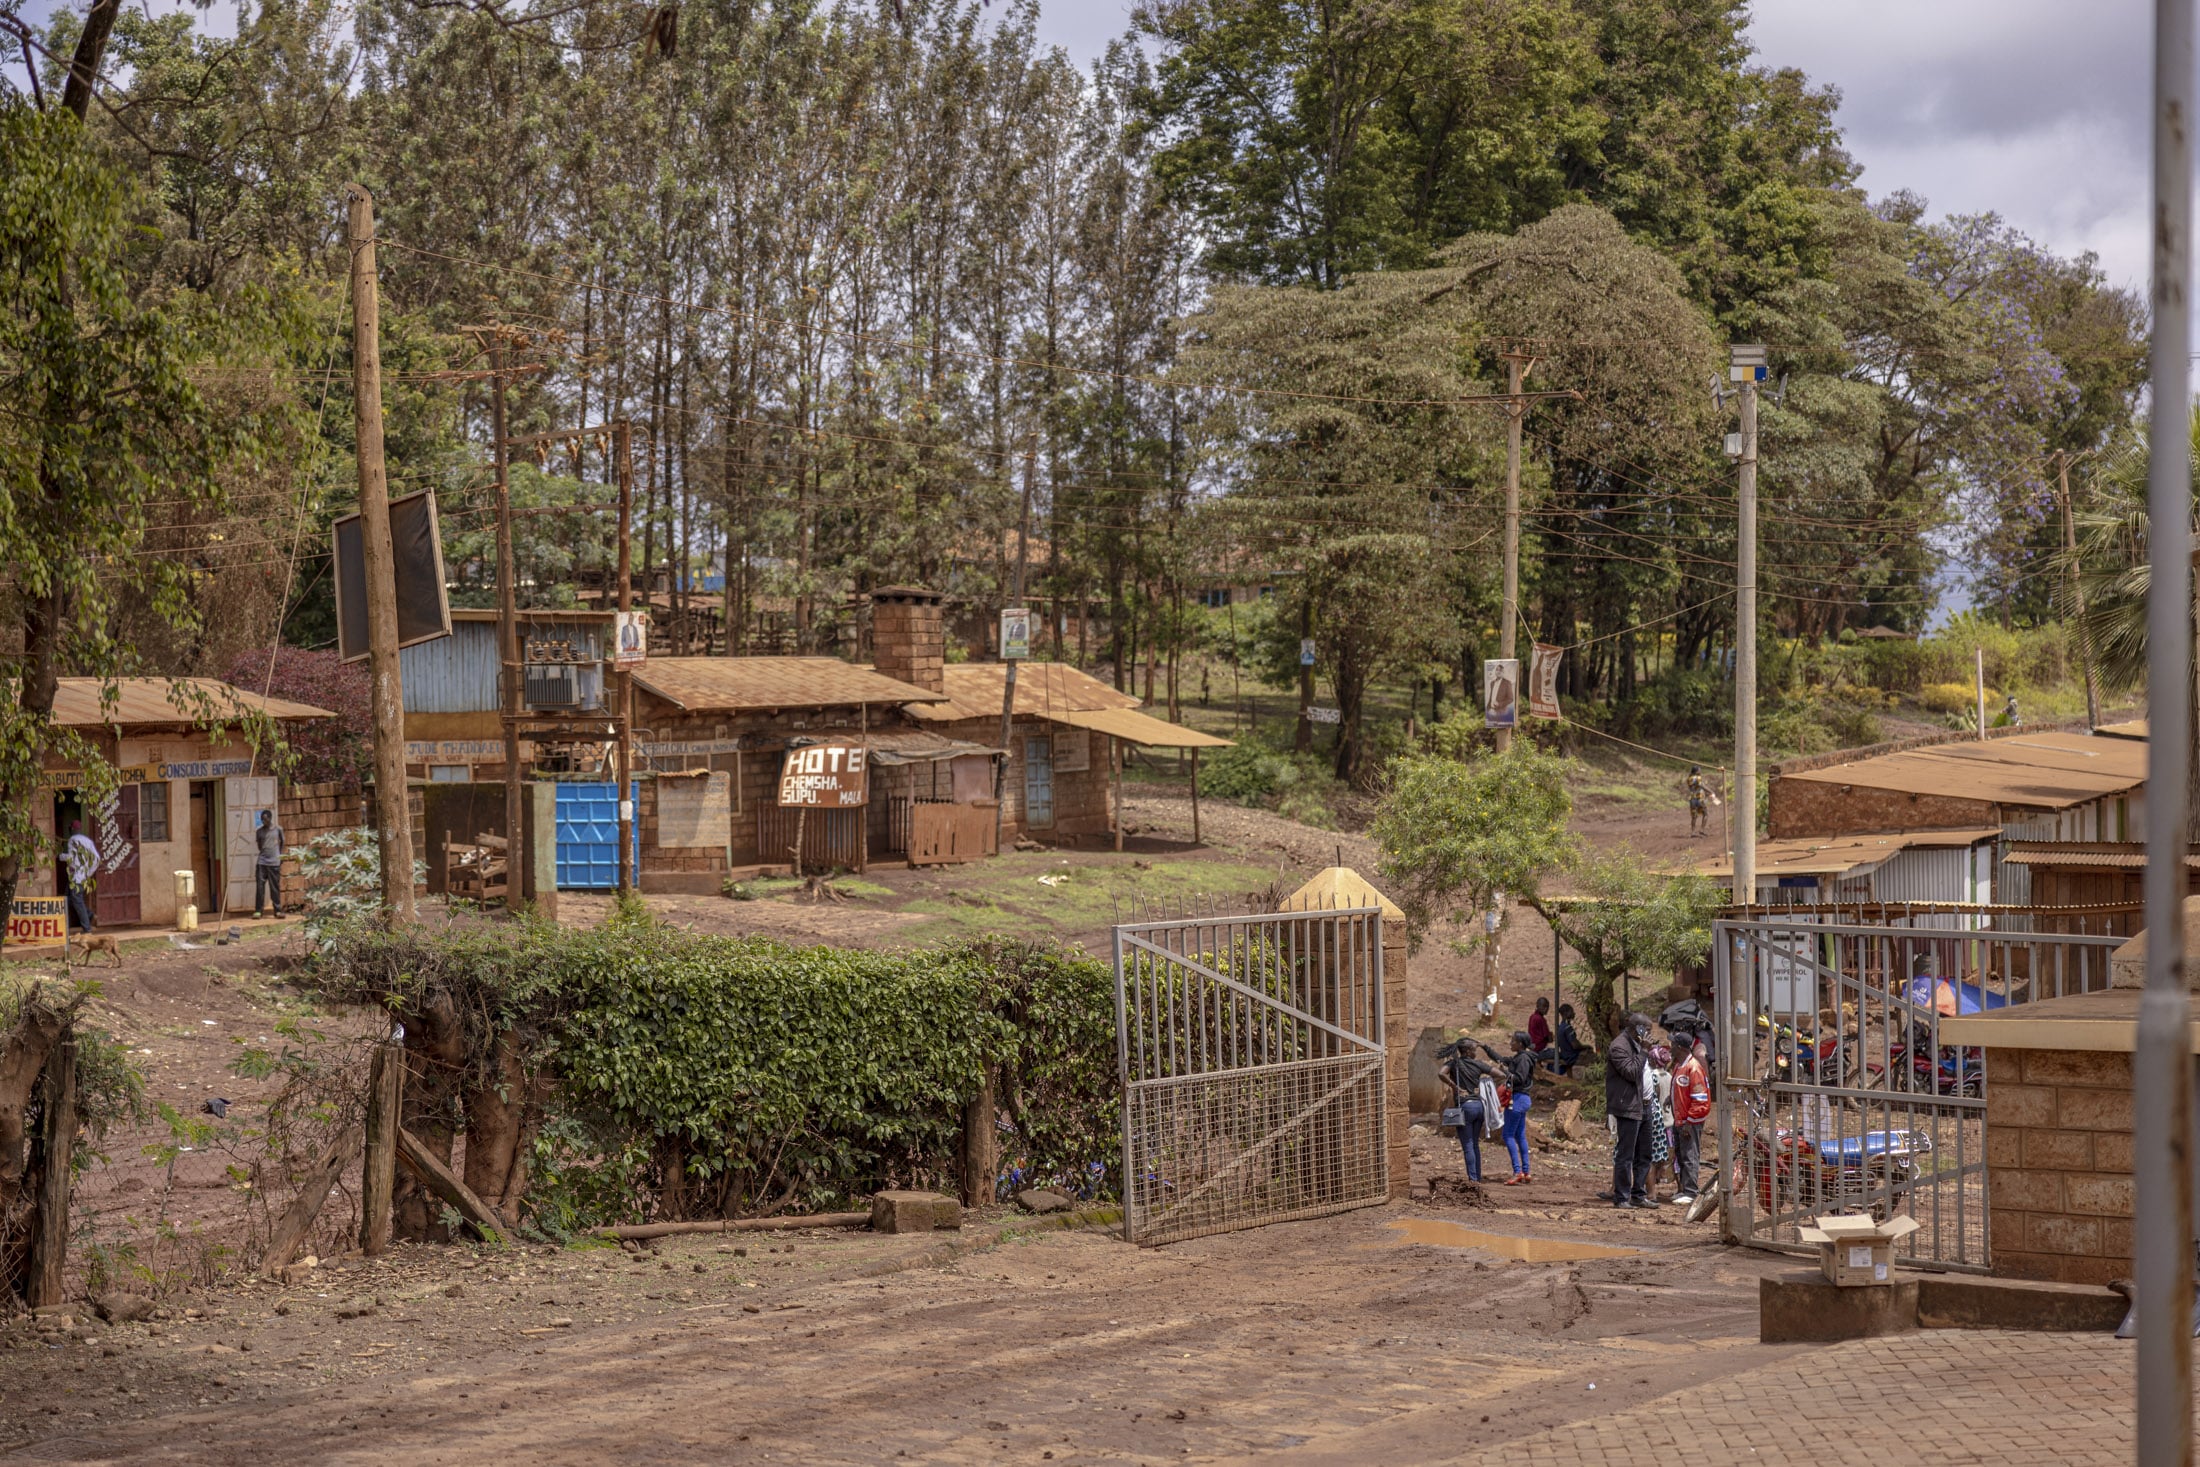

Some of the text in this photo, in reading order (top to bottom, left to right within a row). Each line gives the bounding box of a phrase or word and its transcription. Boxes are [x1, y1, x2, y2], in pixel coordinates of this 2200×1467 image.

[408, 742, 438, 755] JUDE
[157, 762, 208, 779] CONSCIOUS
[781, 789, 821, 804] SUPU.
[5, 919, 63, 937] HOTEL
